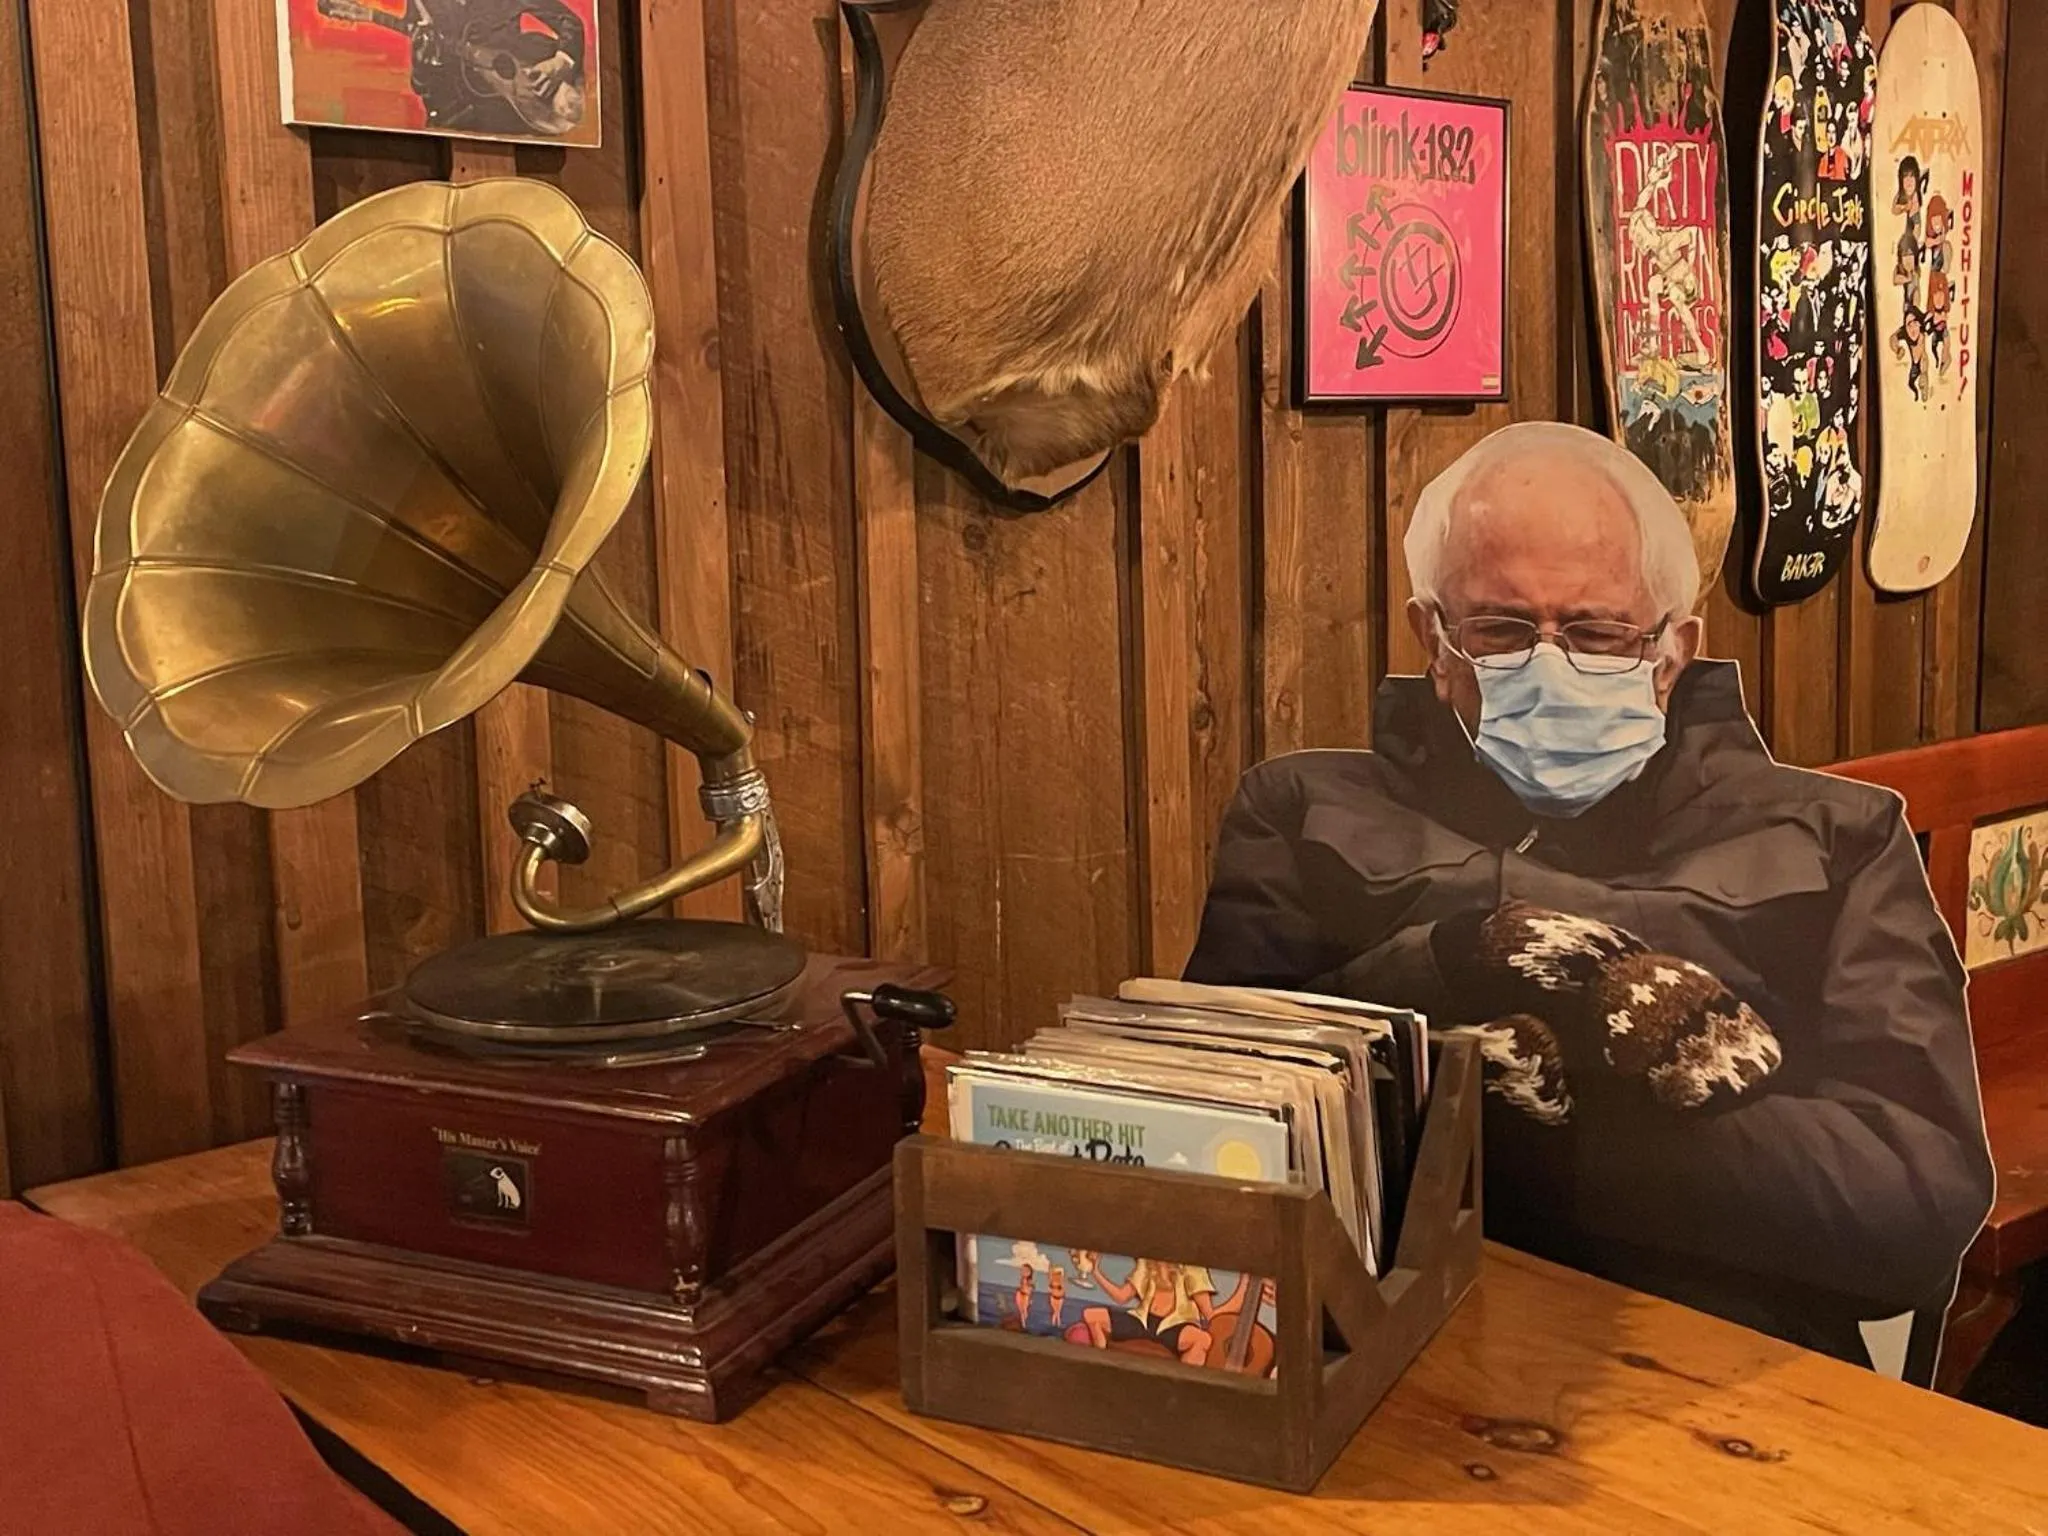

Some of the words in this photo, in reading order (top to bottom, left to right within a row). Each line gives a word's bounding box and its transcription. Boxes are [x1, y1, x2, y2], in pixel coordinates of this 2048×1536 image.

[1889, 112, 1972, 163] ANTHRAX
[1961, 171, 1973, 272] MOSH
[1960, 275, 1971, 314] IT
[1958, 324, 1971, 402] UP!
[986, 1103, 1029, 1132] TAKE
[1034, 1111, 1114, 1144] ANOTHER
[1119, 1121, 1146, 1148] HIT
